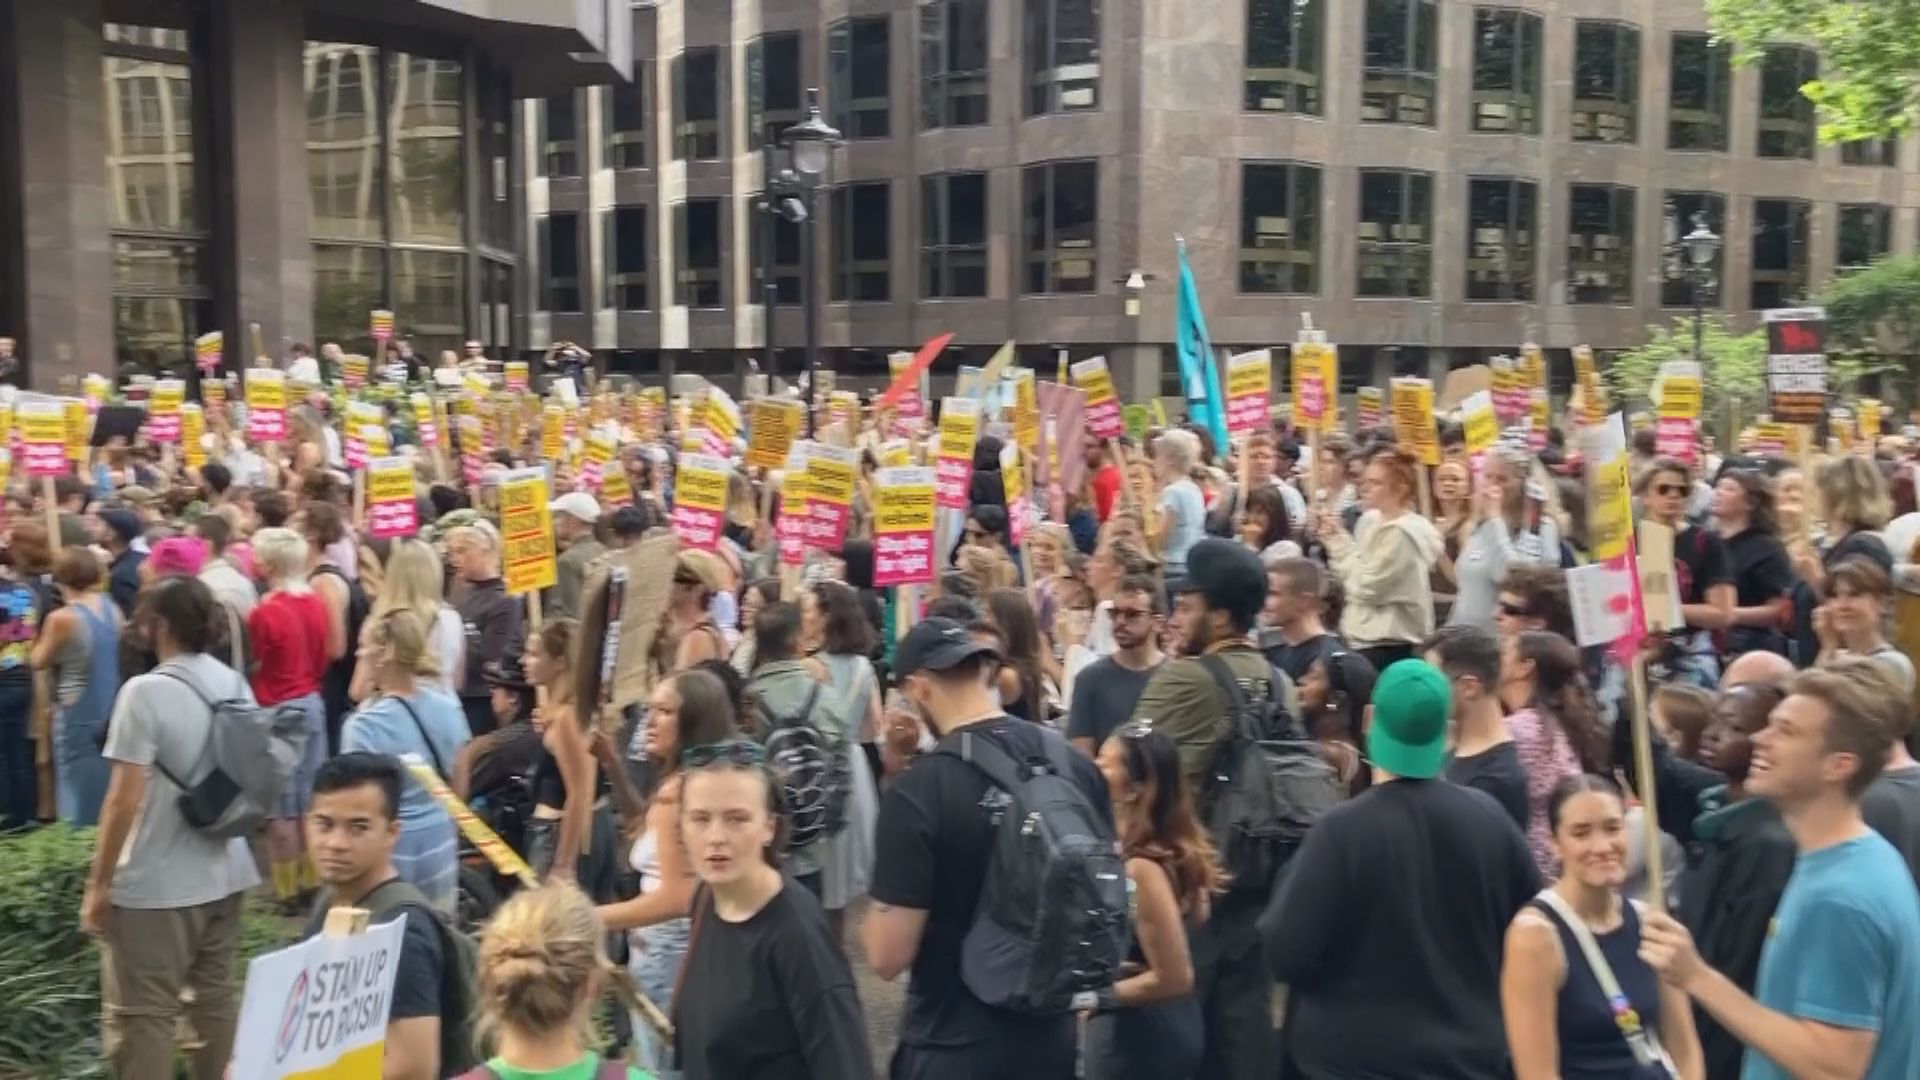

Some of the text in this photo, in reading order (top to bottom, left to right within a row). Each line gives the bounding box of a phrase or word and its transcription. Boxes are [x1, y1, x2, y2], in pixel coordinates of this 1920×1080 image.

[363, 949, 388, 989] UP
[303, 990, 386, 1053] TO RCISM
